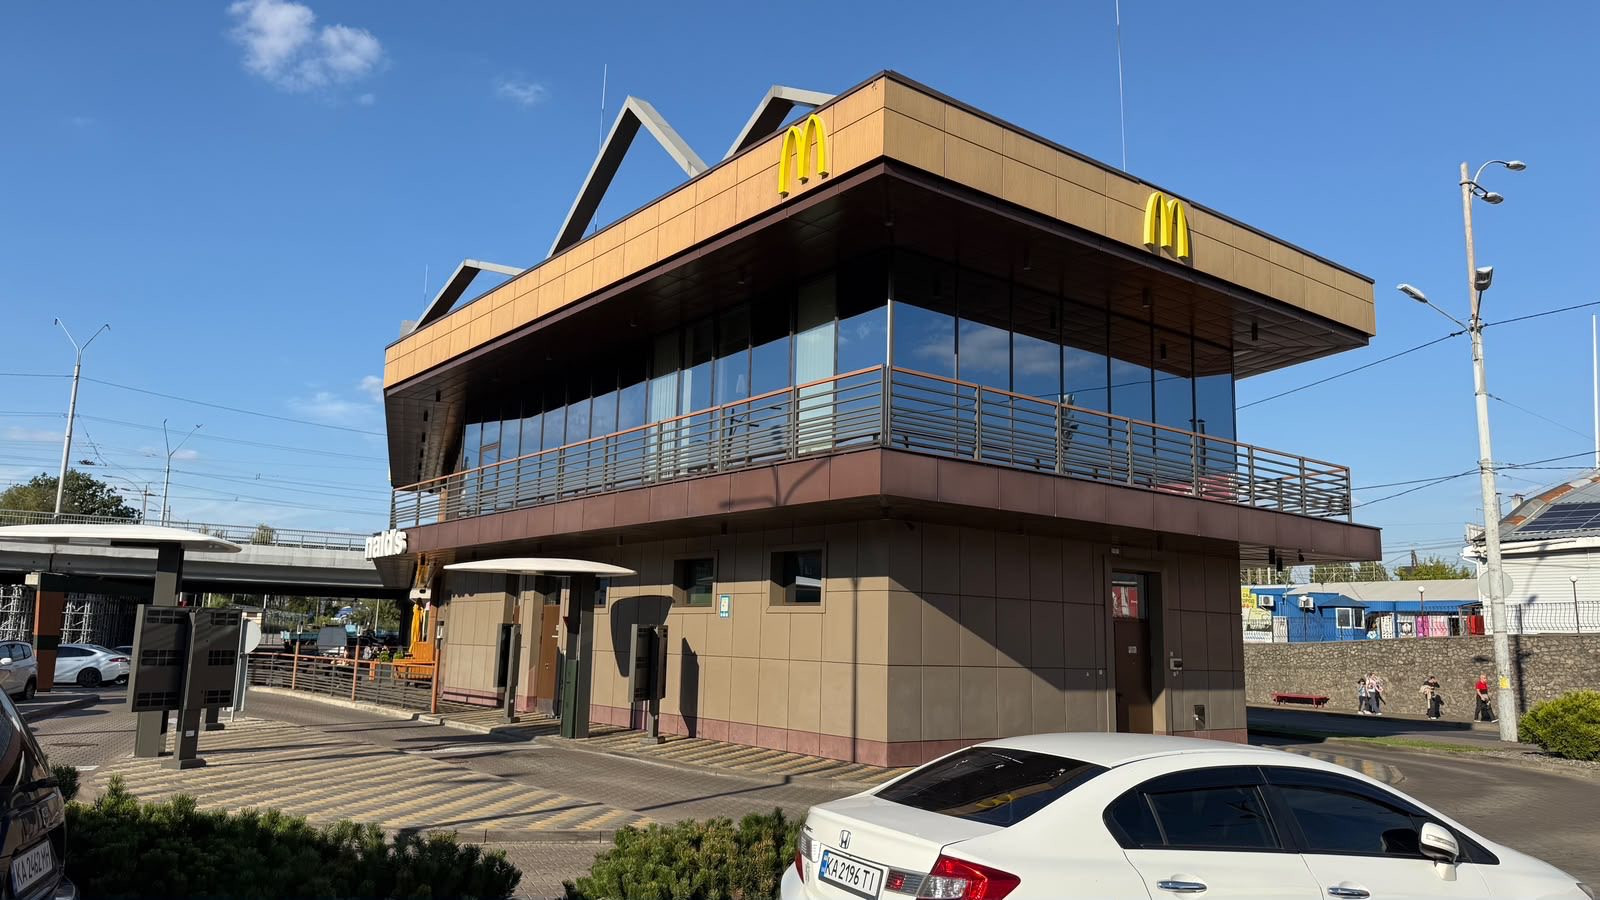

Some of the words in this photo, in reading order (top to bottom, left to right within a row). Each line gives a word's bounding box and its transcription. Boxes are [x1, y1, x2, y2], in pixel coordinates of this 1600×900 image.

[15, 861, 28, 887] KA
[825, 857, 839, 878] KA
[838, 862, 861, 885] 2196
[862, 869, 875, 891] TI
